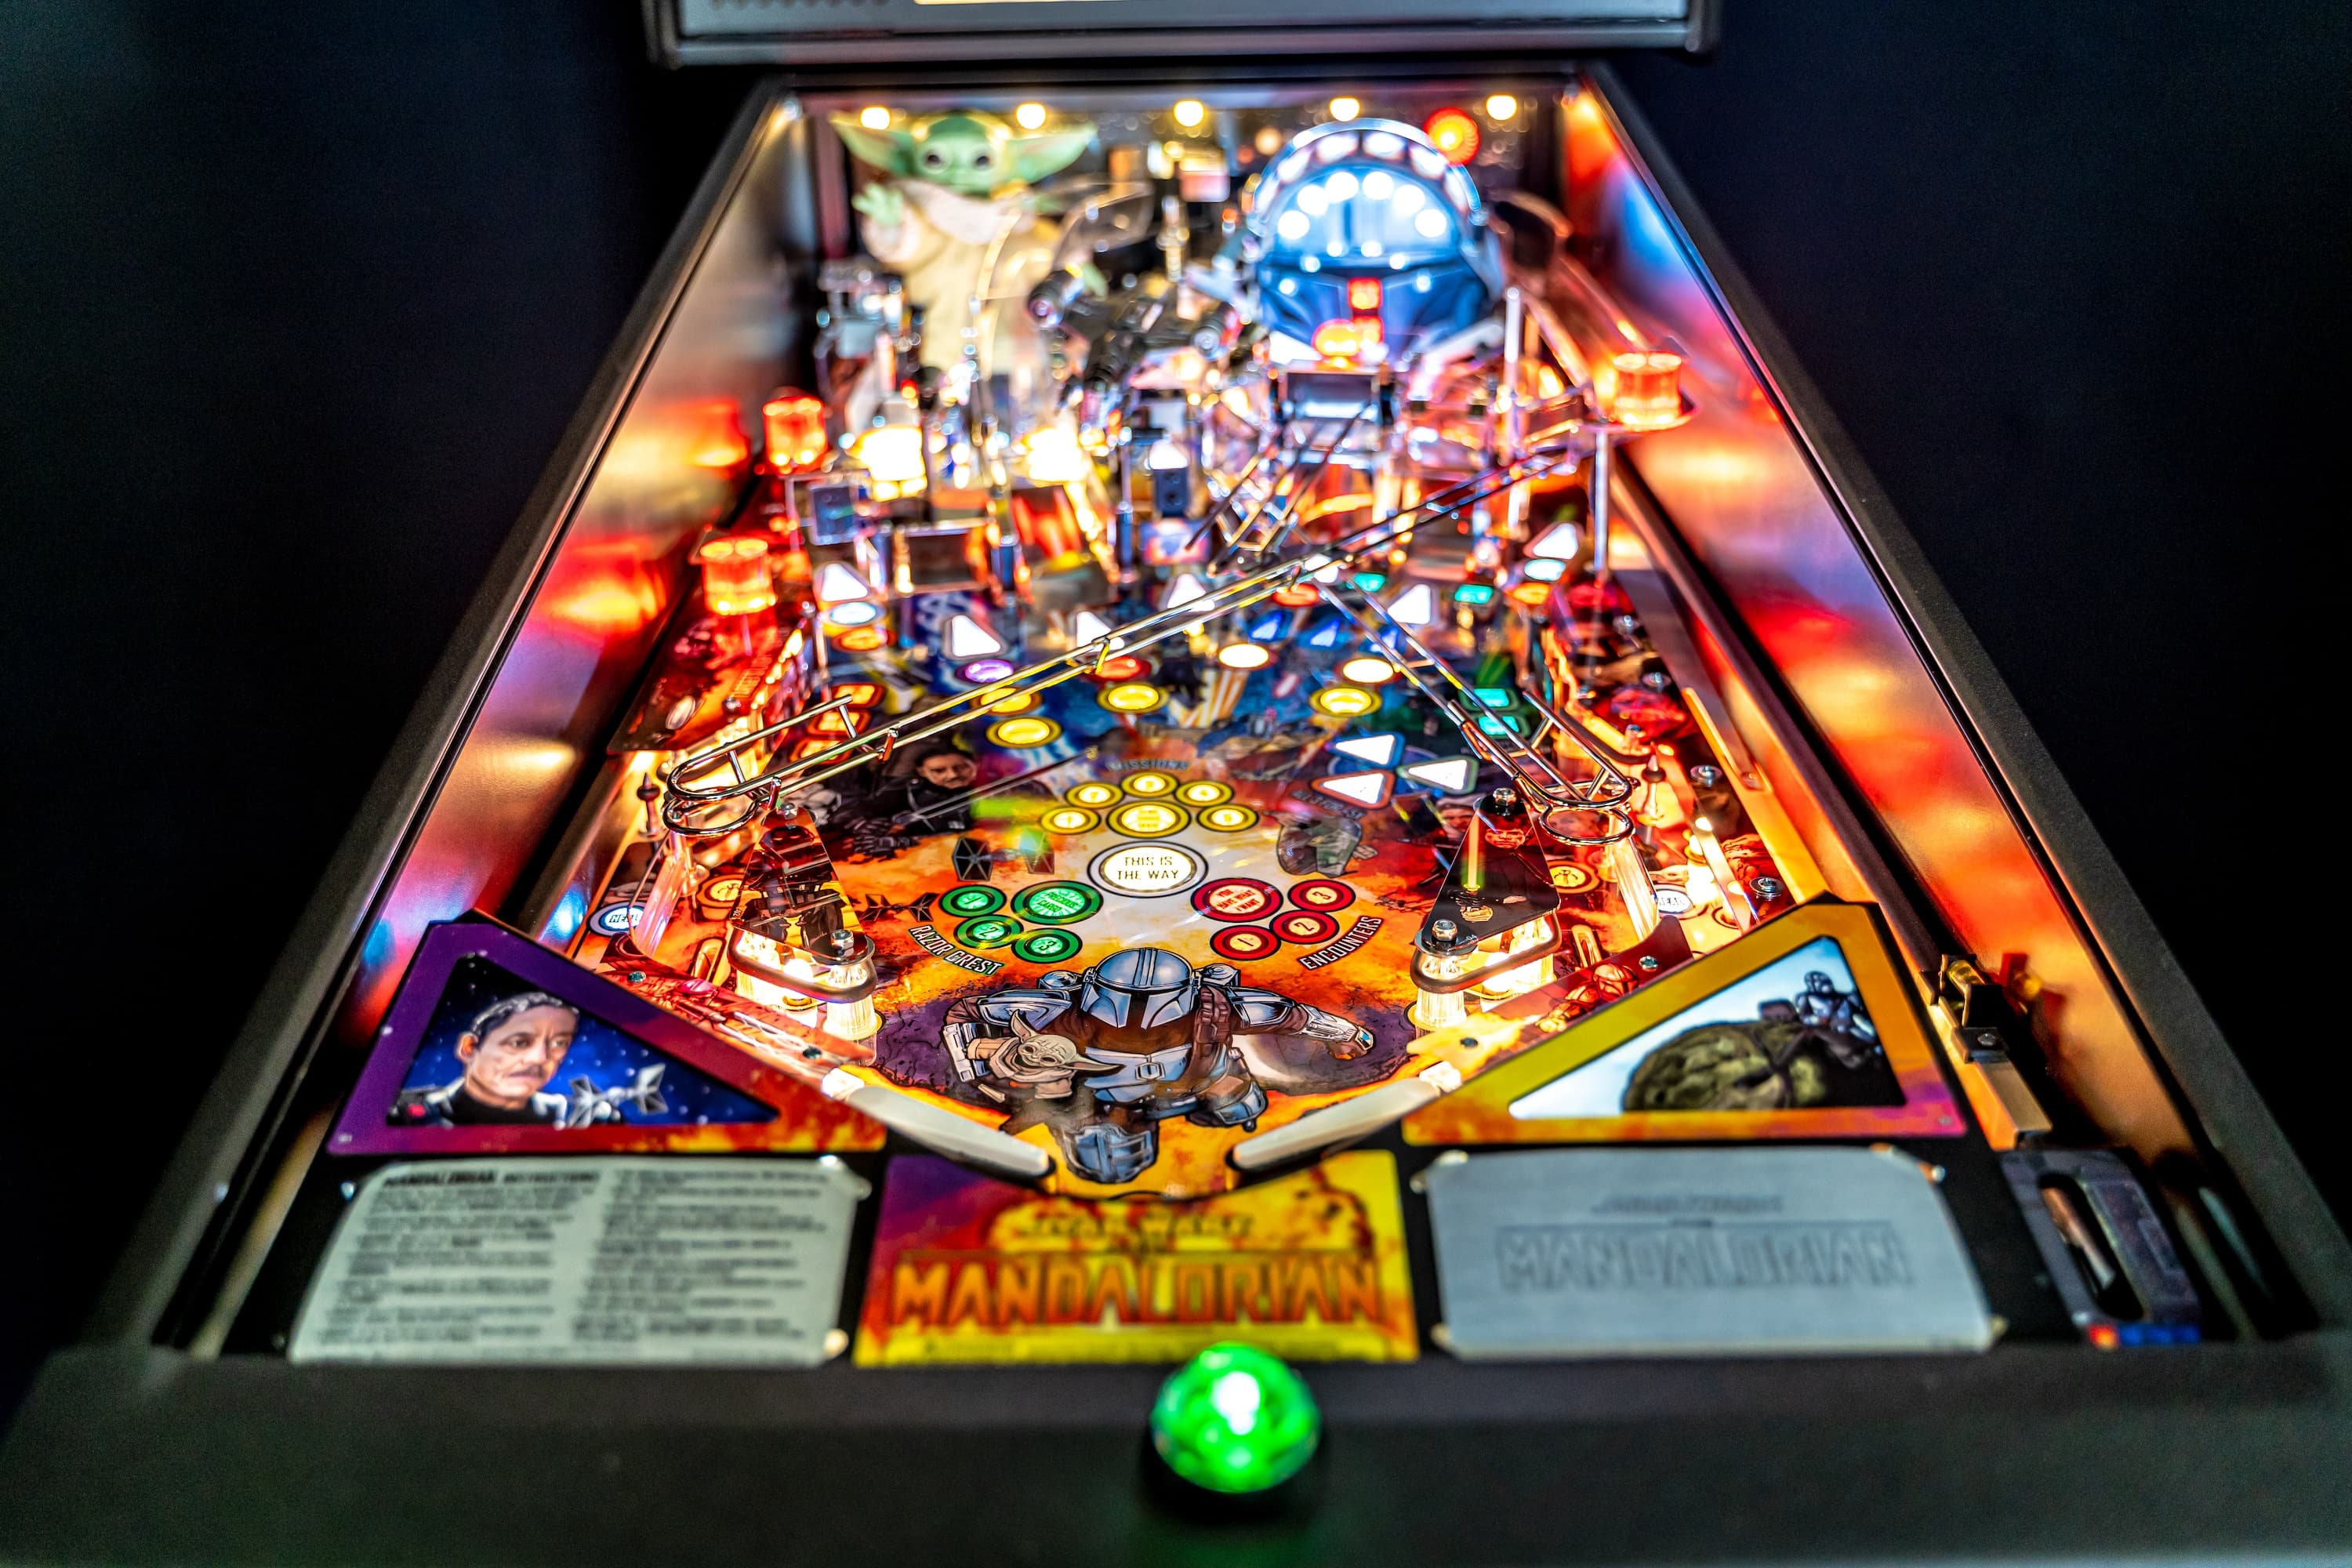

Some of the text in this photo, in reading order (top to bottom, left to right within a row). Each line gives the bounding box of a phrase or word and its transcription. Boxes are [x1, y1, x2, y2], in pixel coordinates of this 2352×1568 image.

[1124, 855, 1173, 866] THIS IS
[1117, 869, 1179, 880] THE WAY
[1312, 891, 1332, 900] 3
[1240, 898, 1261, 909] WANT
[1294, 921, 1316, 931] 2
[979, 927, 1000, 938] 2
[1039, 941, 1056, 951] 3
[1237, 938, 1254, 947] 1
[1300, 916, 1382, 970] ENCOUNTERS
[909, 925, 1003, 975] RAZOR CREST
[1494, 1229, 1915, 1292] MANDALORIAN
[894, 1259, 1383, 1327] MANDALORIAN
